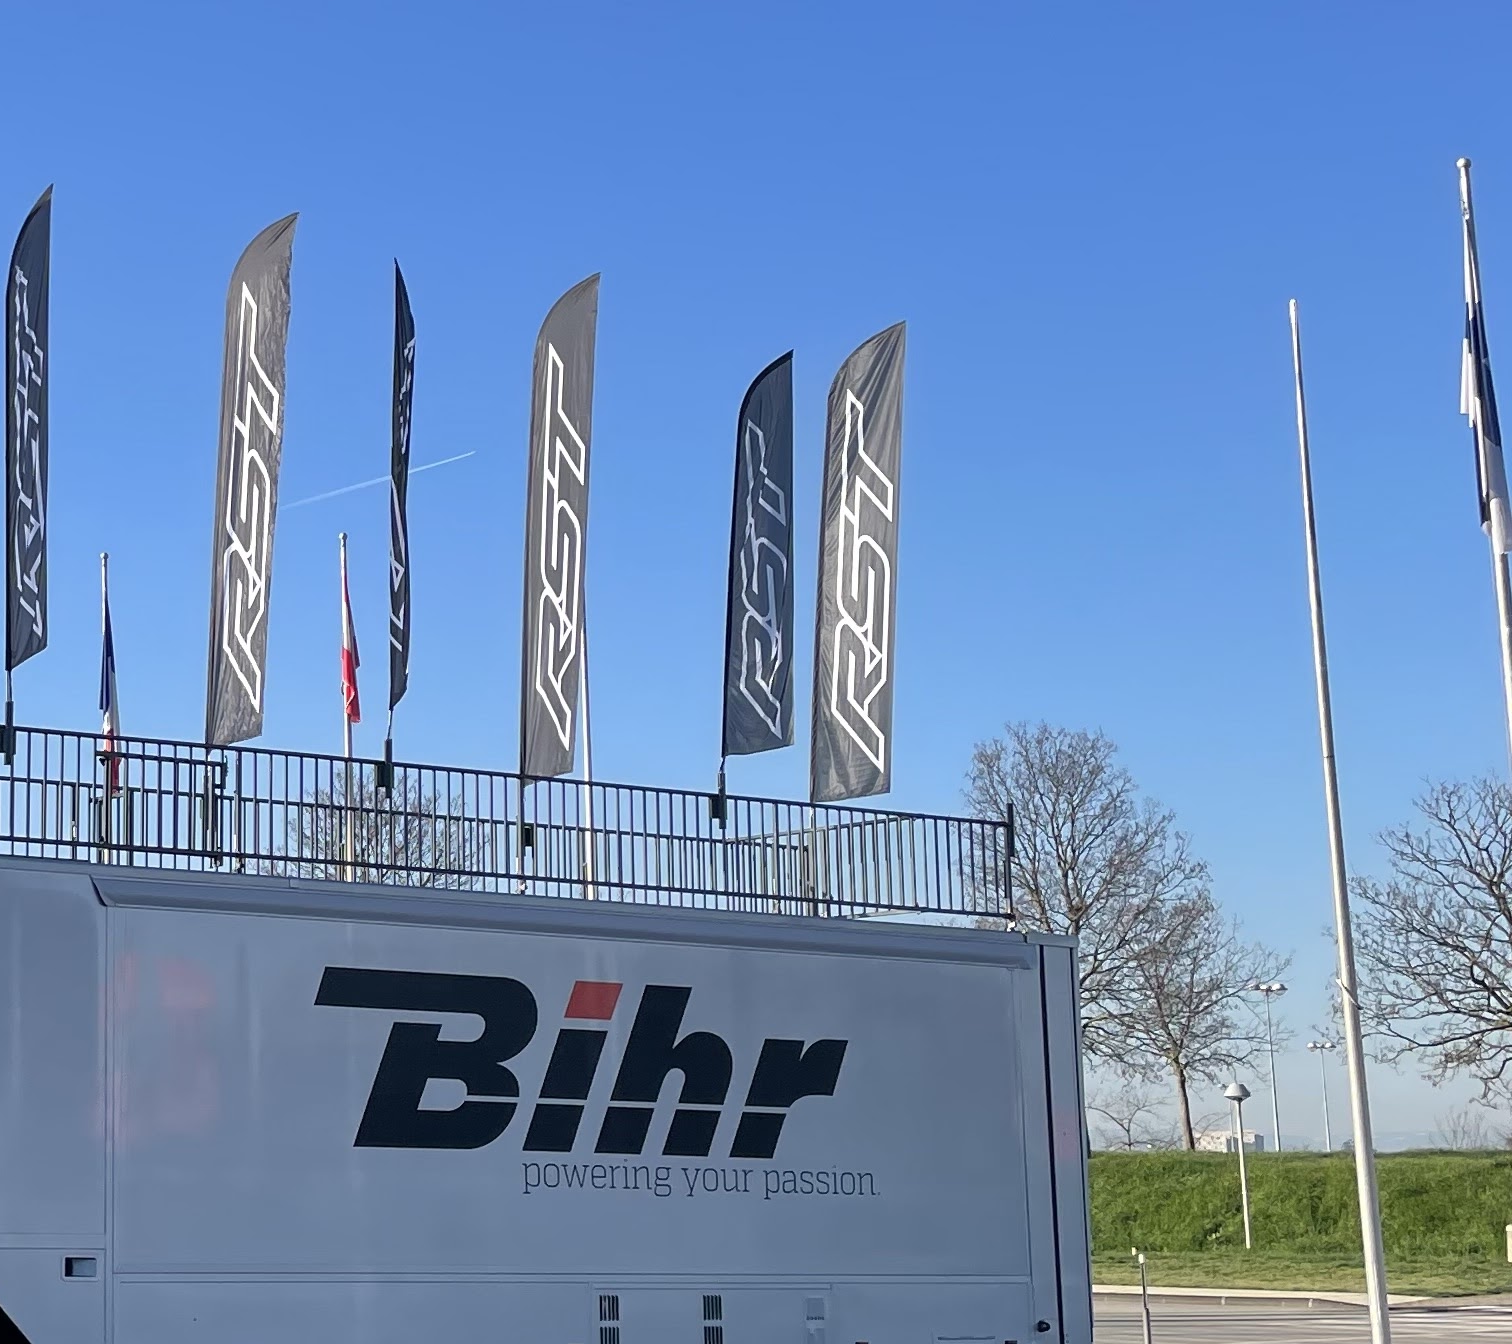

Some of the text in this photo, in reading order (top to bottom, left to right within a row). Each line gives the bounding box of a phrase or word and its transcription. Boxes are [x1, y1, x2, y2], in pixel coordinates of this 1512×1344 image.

[222, 281, 280, 714] RST
[536, 342, 586, 752] RST
[739, 418, 788, 741] RST
[831, 388, 895, 774] RST
[313, 965, 849, 1159] Bihr
[521, 1158, 882, 1201] powering your passion.
